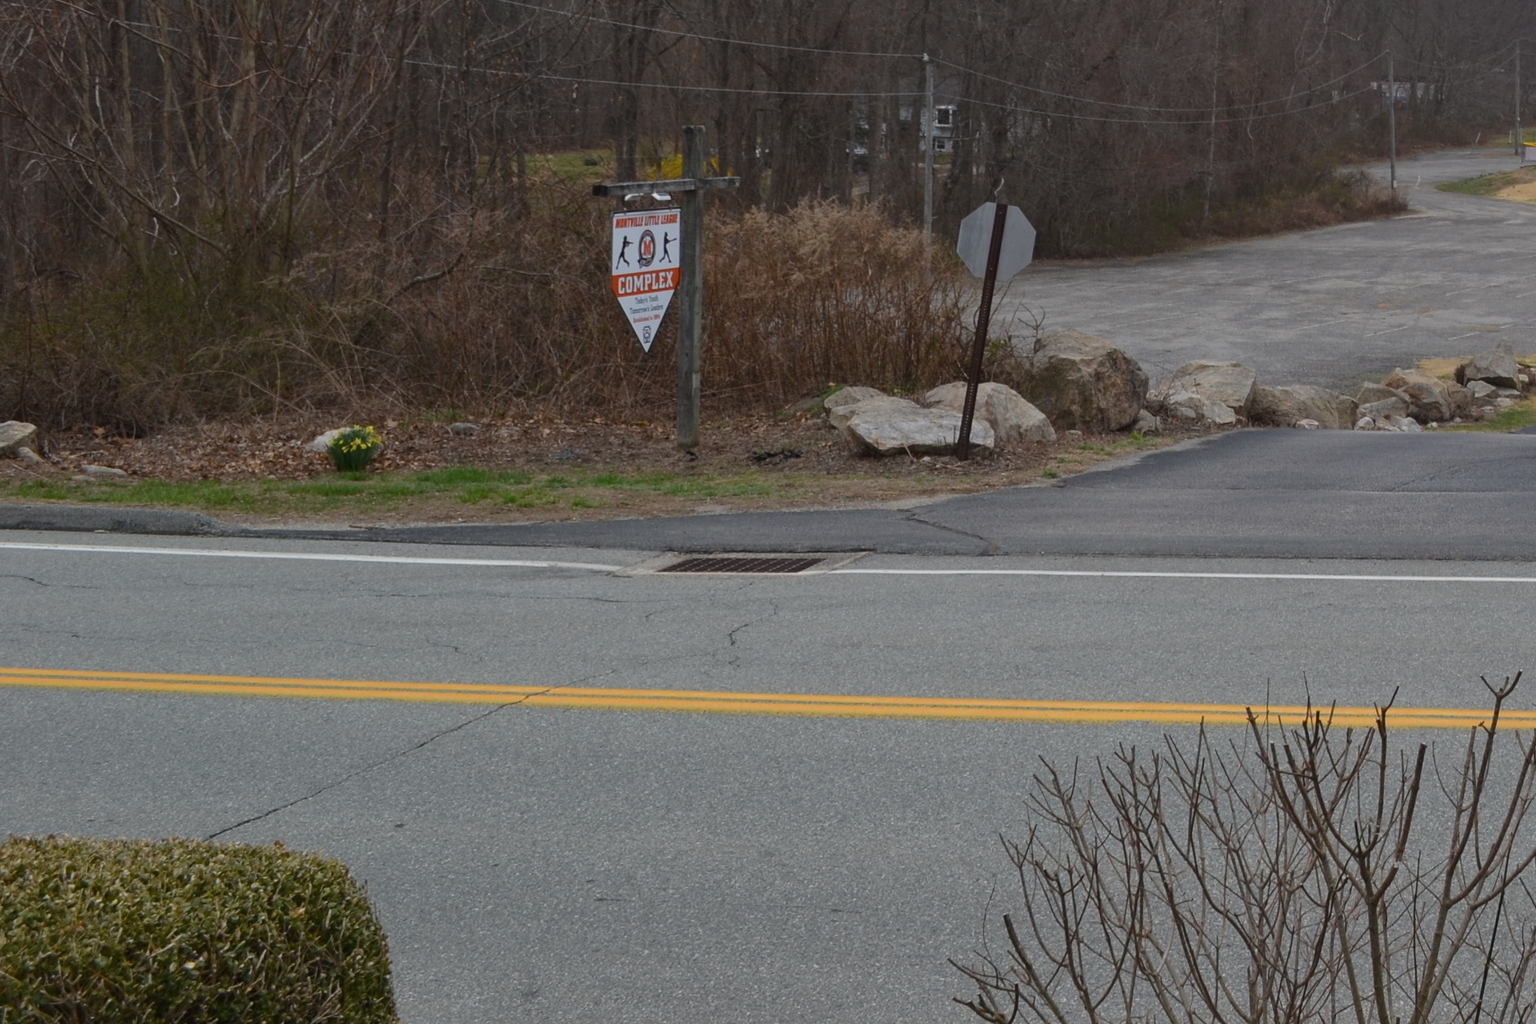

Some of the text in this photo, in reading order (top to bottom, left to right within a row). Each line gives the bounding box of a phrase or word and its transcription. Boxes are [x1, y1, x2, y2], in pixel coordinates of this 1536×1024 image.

[644, 215, 660, 226] LITTLE
[661, 214, 678, 225] LEAGUE
[618, 271, 673, 294] COMPLEX
